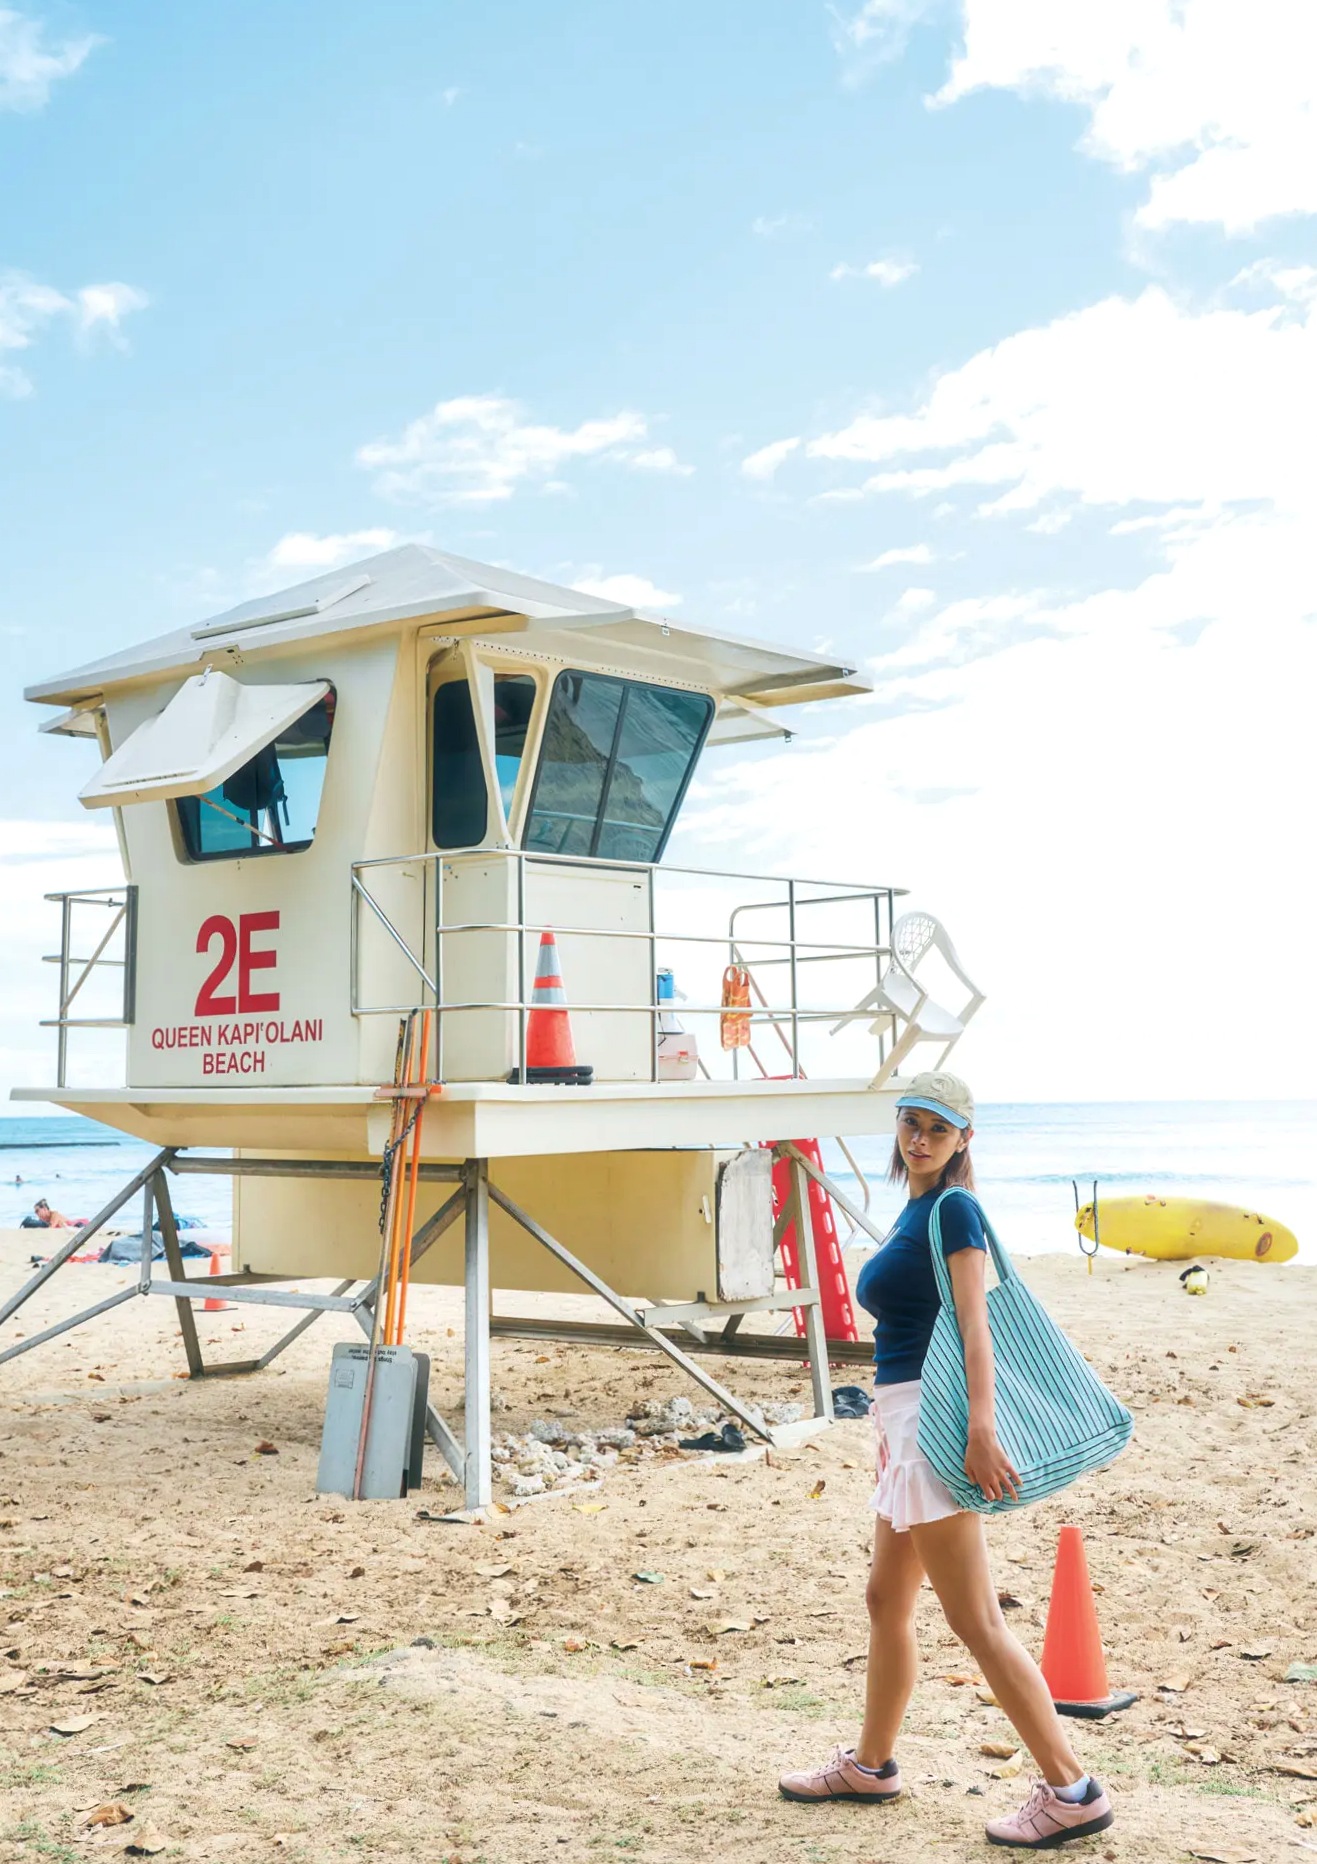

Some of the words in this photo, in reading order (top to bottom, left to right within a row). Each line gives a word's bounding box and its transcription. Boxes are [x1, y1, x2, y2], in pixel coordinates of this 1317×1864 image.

[194, 910, 280, 1016] 2E
[151, 1025, 212, 1050] QUEEN
[203, 1051, 265, 1075] BEACH
